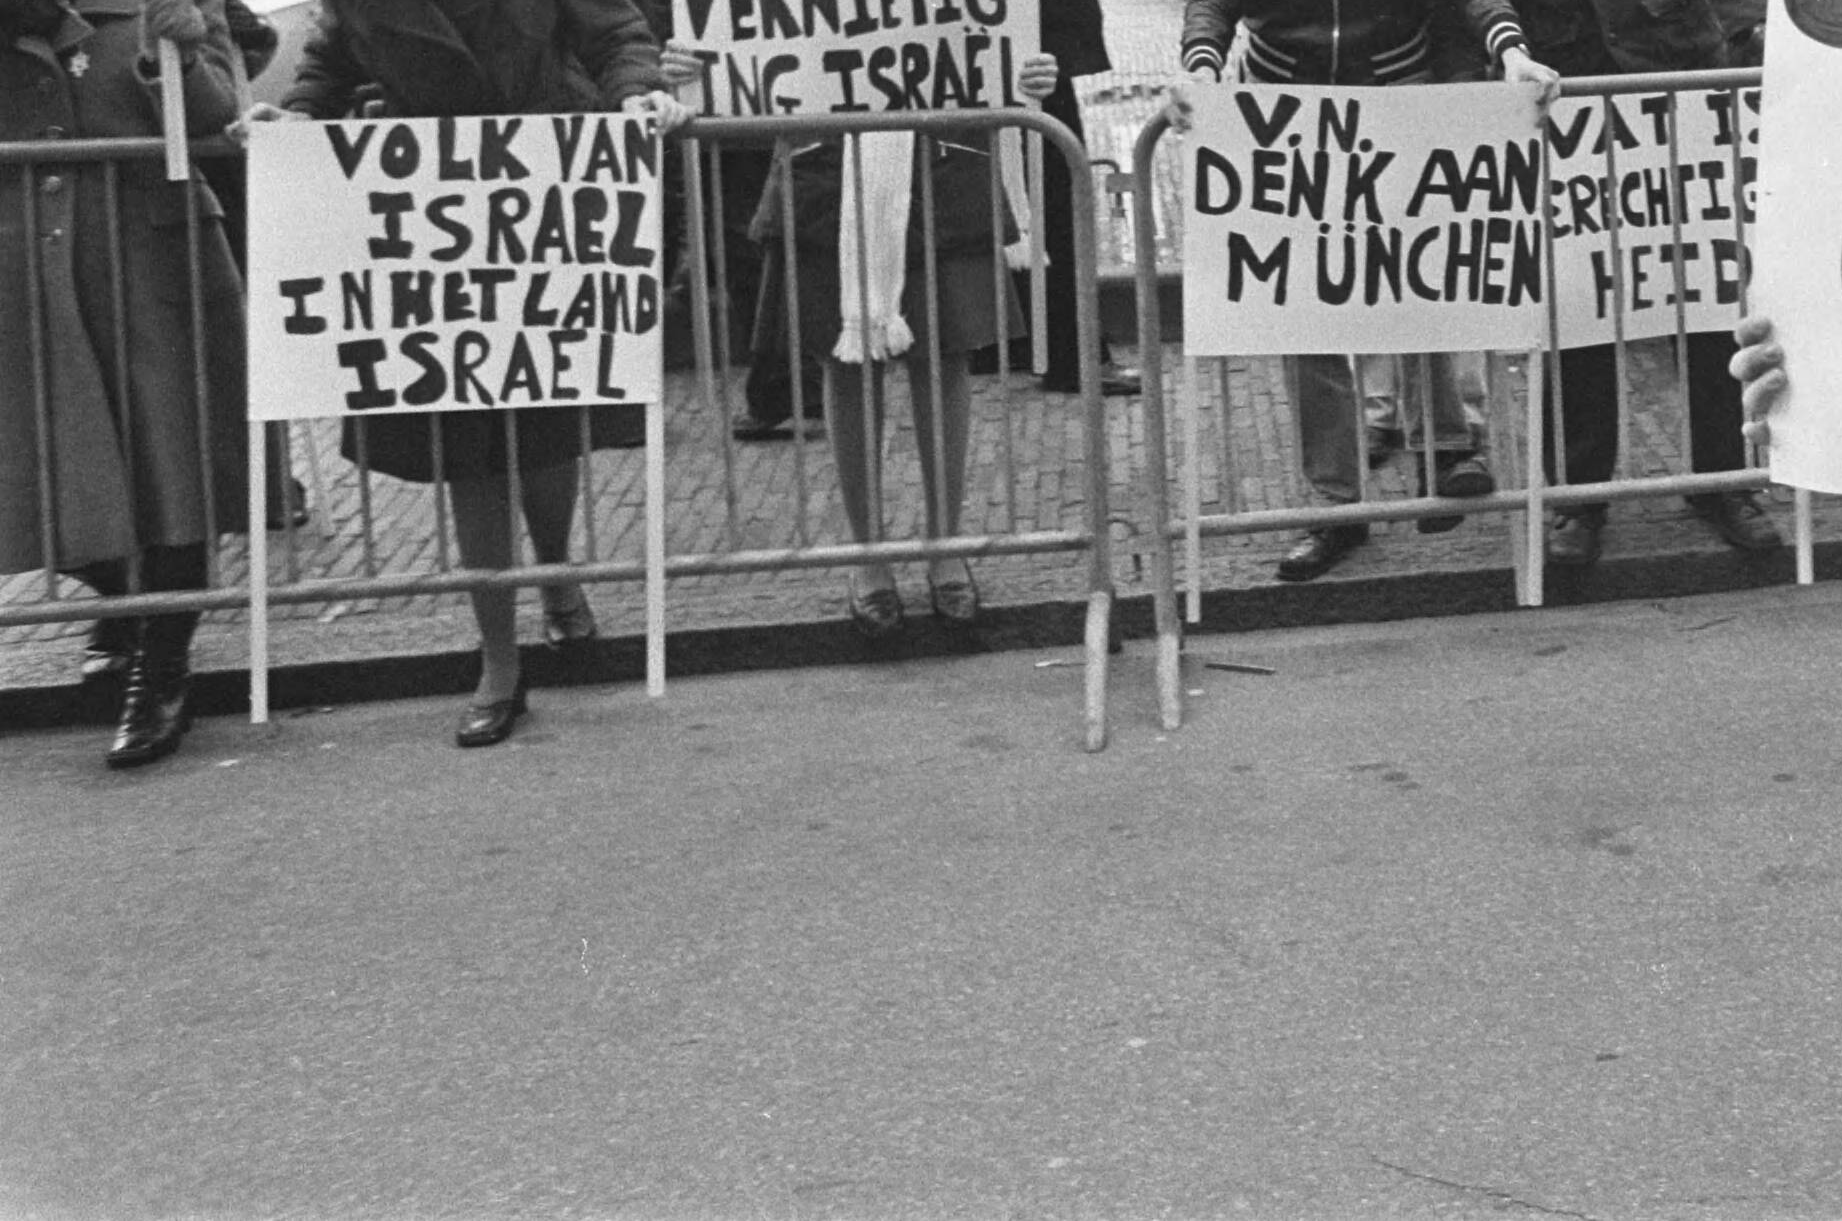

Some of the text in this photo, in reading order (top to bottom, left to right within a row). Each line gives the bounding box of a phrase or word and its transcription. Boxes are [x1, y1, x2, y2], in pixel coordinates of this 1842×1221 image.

[695, 50, 802, 117] ING
[325, 115, 658, 184] VOLK VAN
[1235, 91, 1373, 153] V.N.
[1195, 138, 1541, 224] DENK AAN
[368, 184, 656, 268] ISRAEL
[1227, 218, 1542, 307] MÜNCHEN
[280, 268, 658, 335] IN HET LAND
[337, 330, 626, 410] ISRAEL
